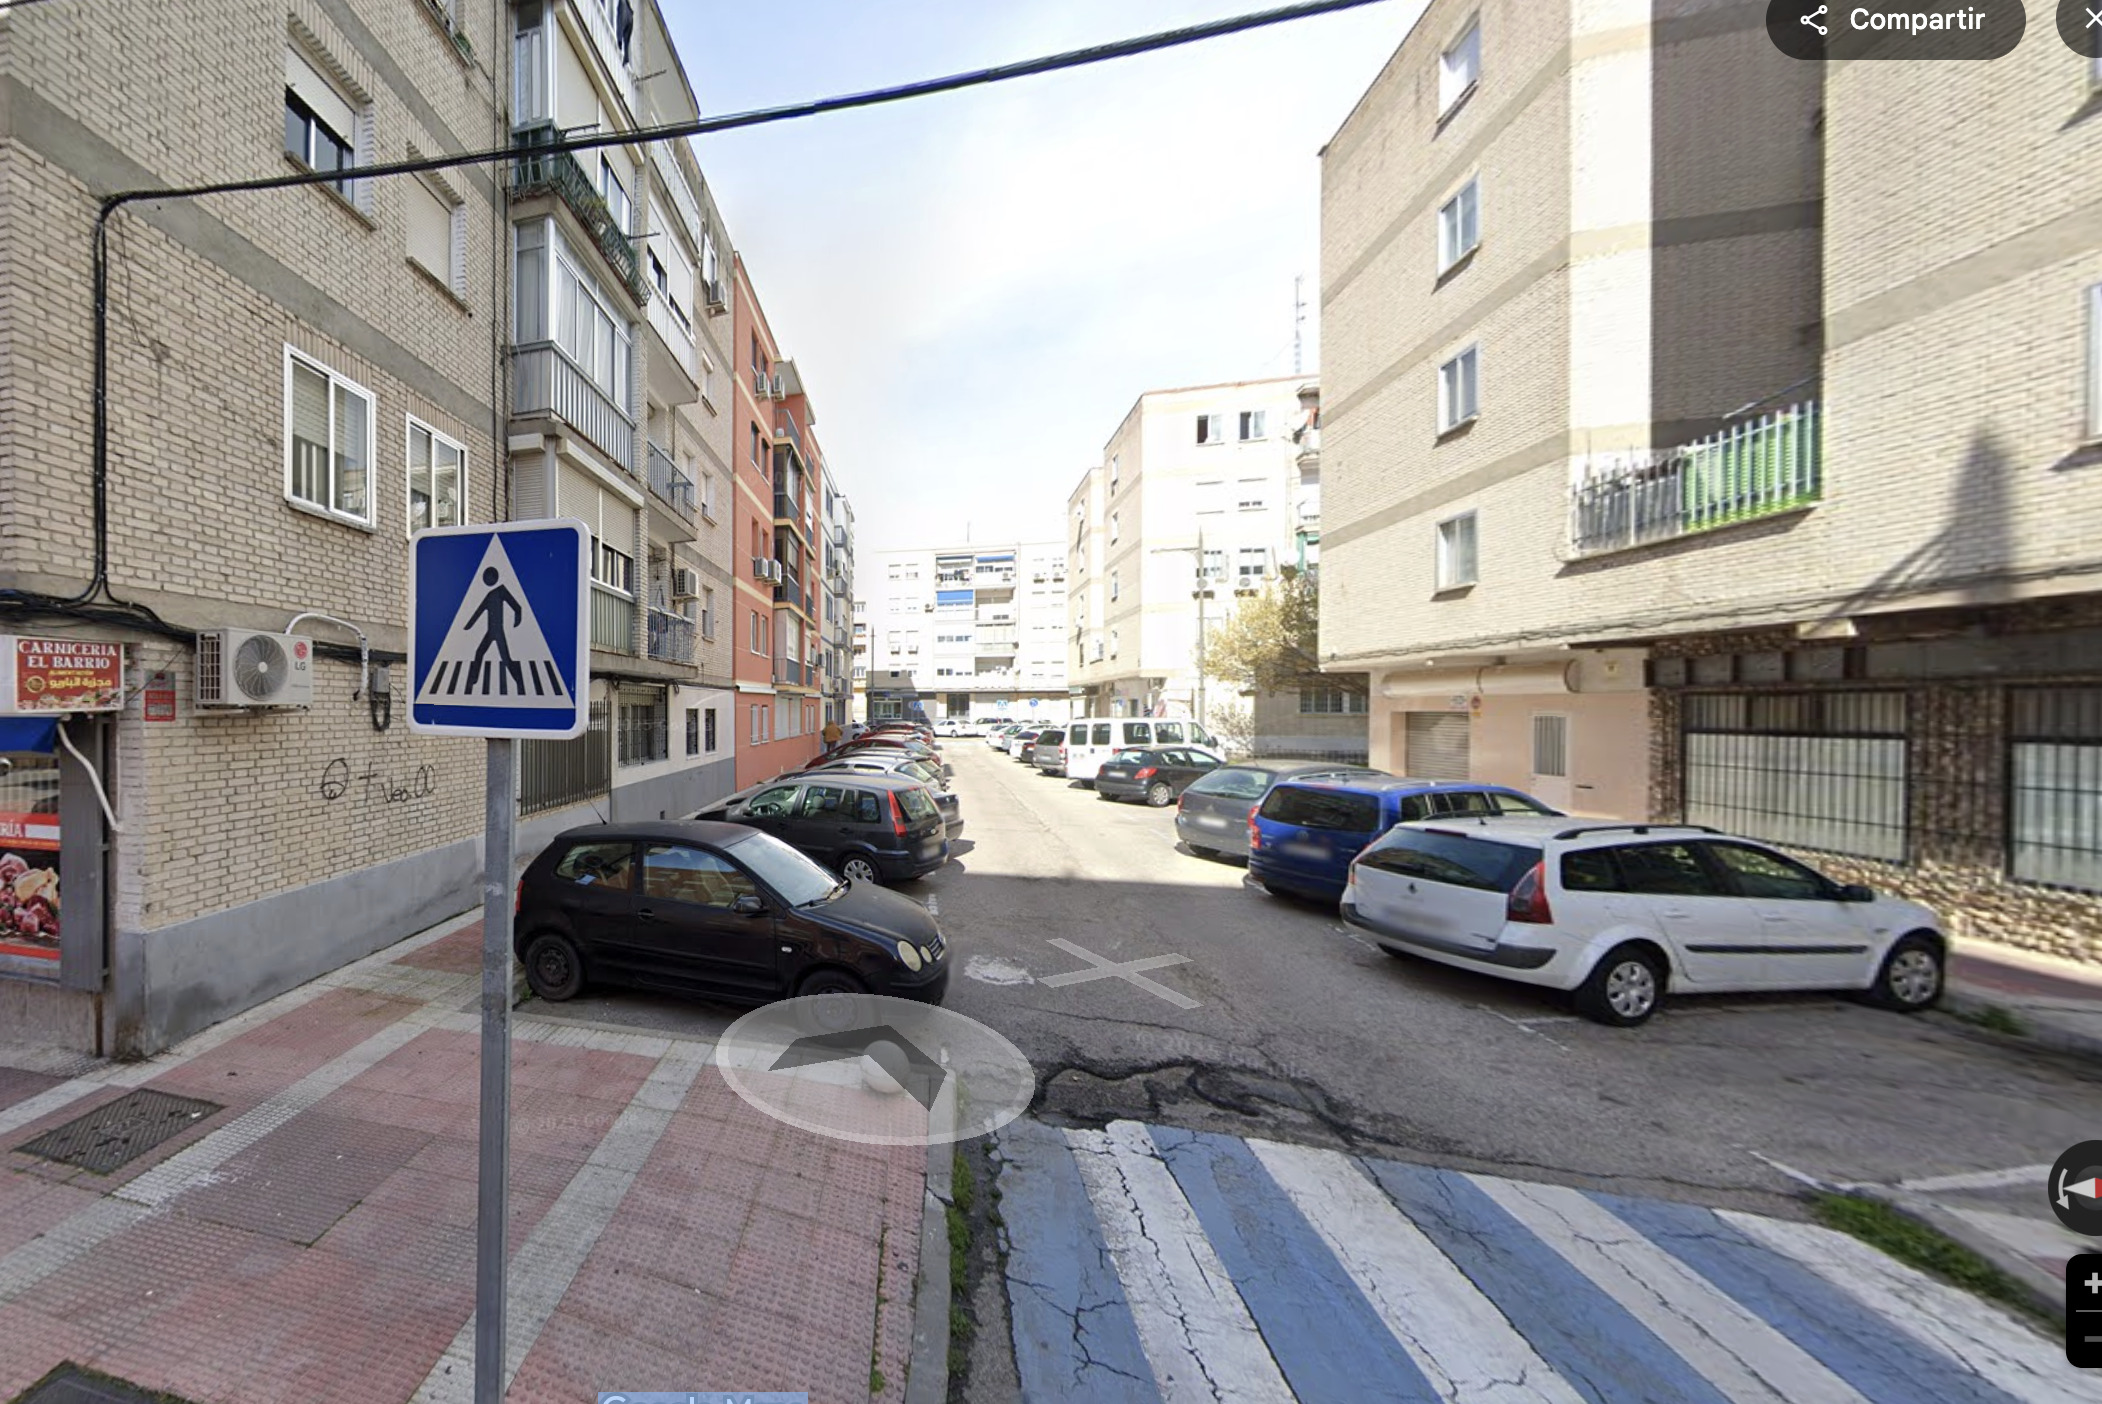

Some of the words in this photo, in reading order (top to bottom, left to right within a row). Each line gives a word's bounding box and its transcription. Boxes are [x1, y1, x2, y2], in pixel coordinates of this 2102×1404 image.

[18, 641, 117, 656] CARNICERIA
[27, 656, 48, 668] EL
[53, 656, 110, 669] BARRIO
[294, 661, 306, 671] LG
